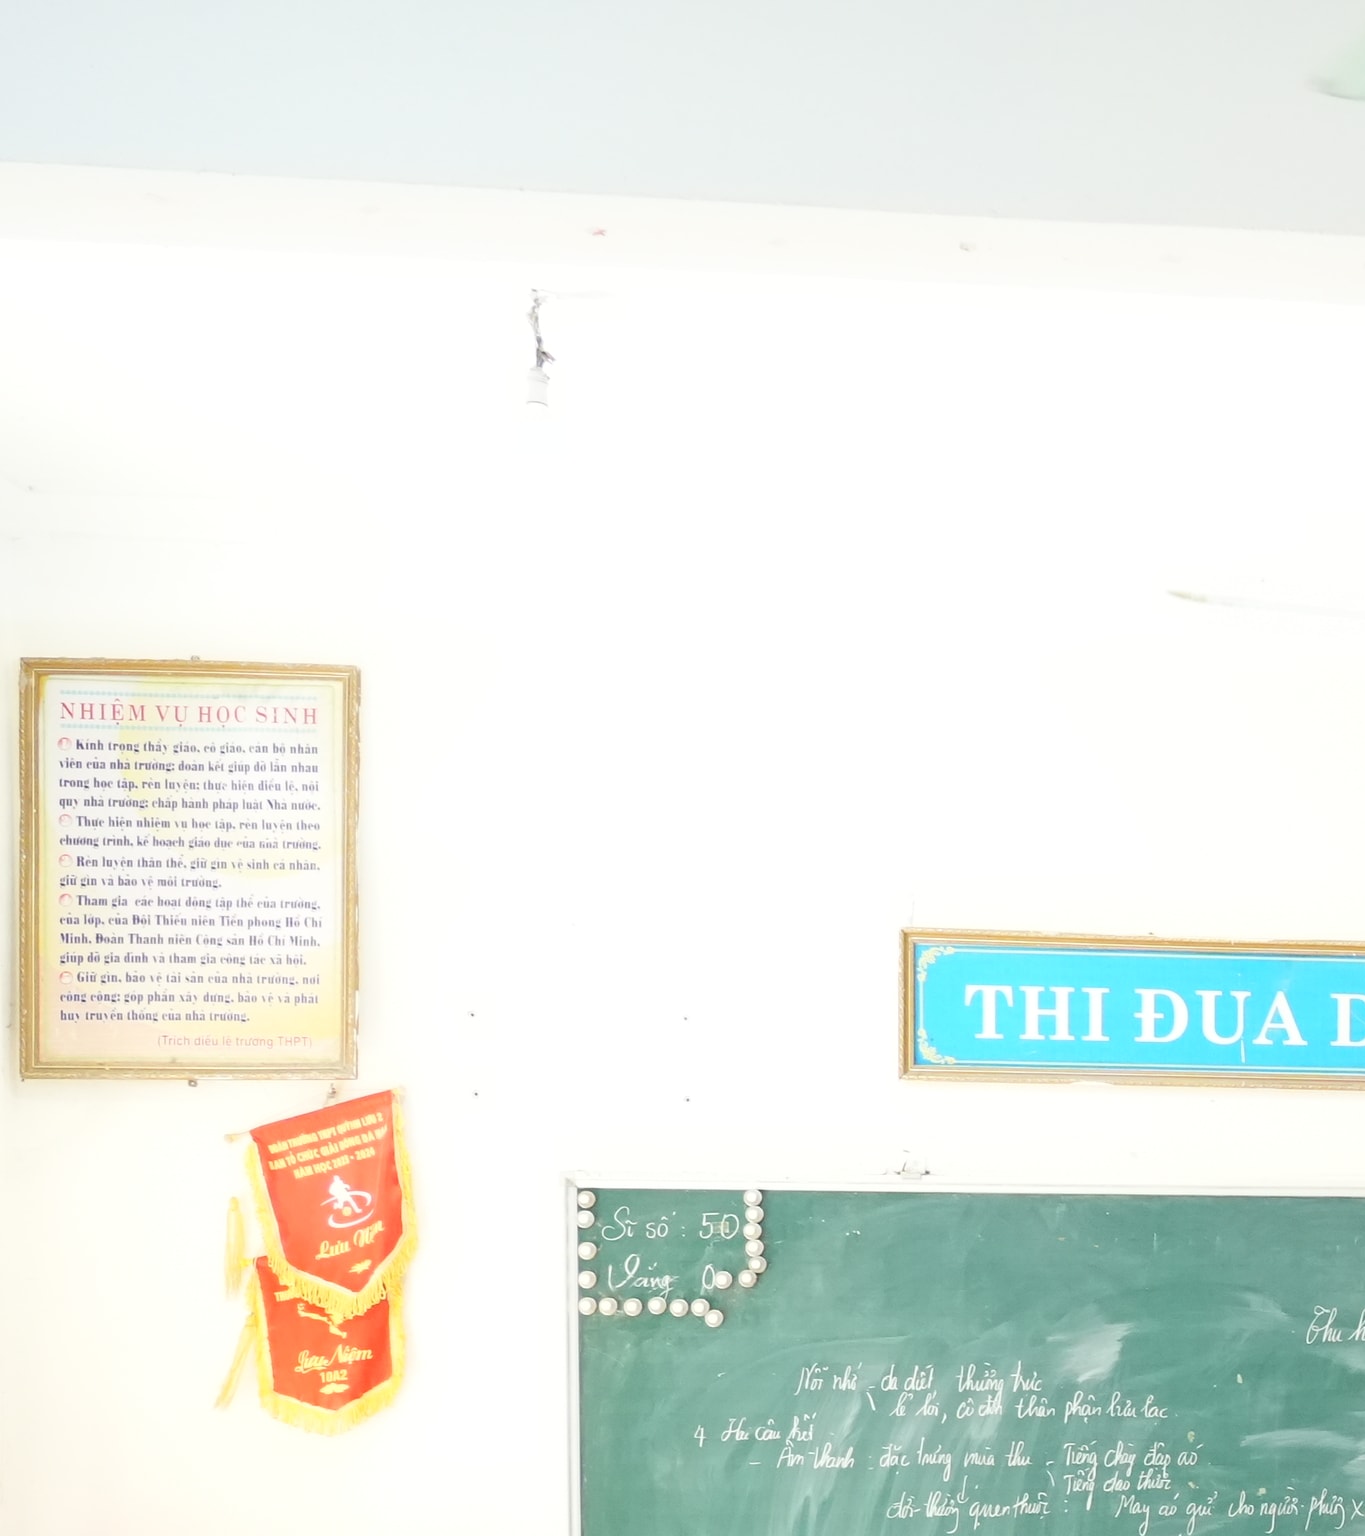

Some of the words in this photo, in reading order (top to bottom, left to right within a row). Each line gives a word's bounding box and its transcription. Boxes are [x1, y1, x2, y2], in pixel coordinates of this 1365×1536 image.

[60, 698, 147, 725] NHIỆM
[155, 705, 189, 727] VỤ
[198, 705, 246, 727] HỌC
[255, 706, 319, 725] SINH
[128, 933, 164, 945] Thanh
[964, 984, 1112, 1044] THI
[1134, 988, 1309, 1047] ĐUA
[601, 1205, 638, 1241] Sĩ
[645, 1210, 677, 1239] số
[699, 1211, 741, 1240] 50
[319, 1369, 349, 1383] 10A2
